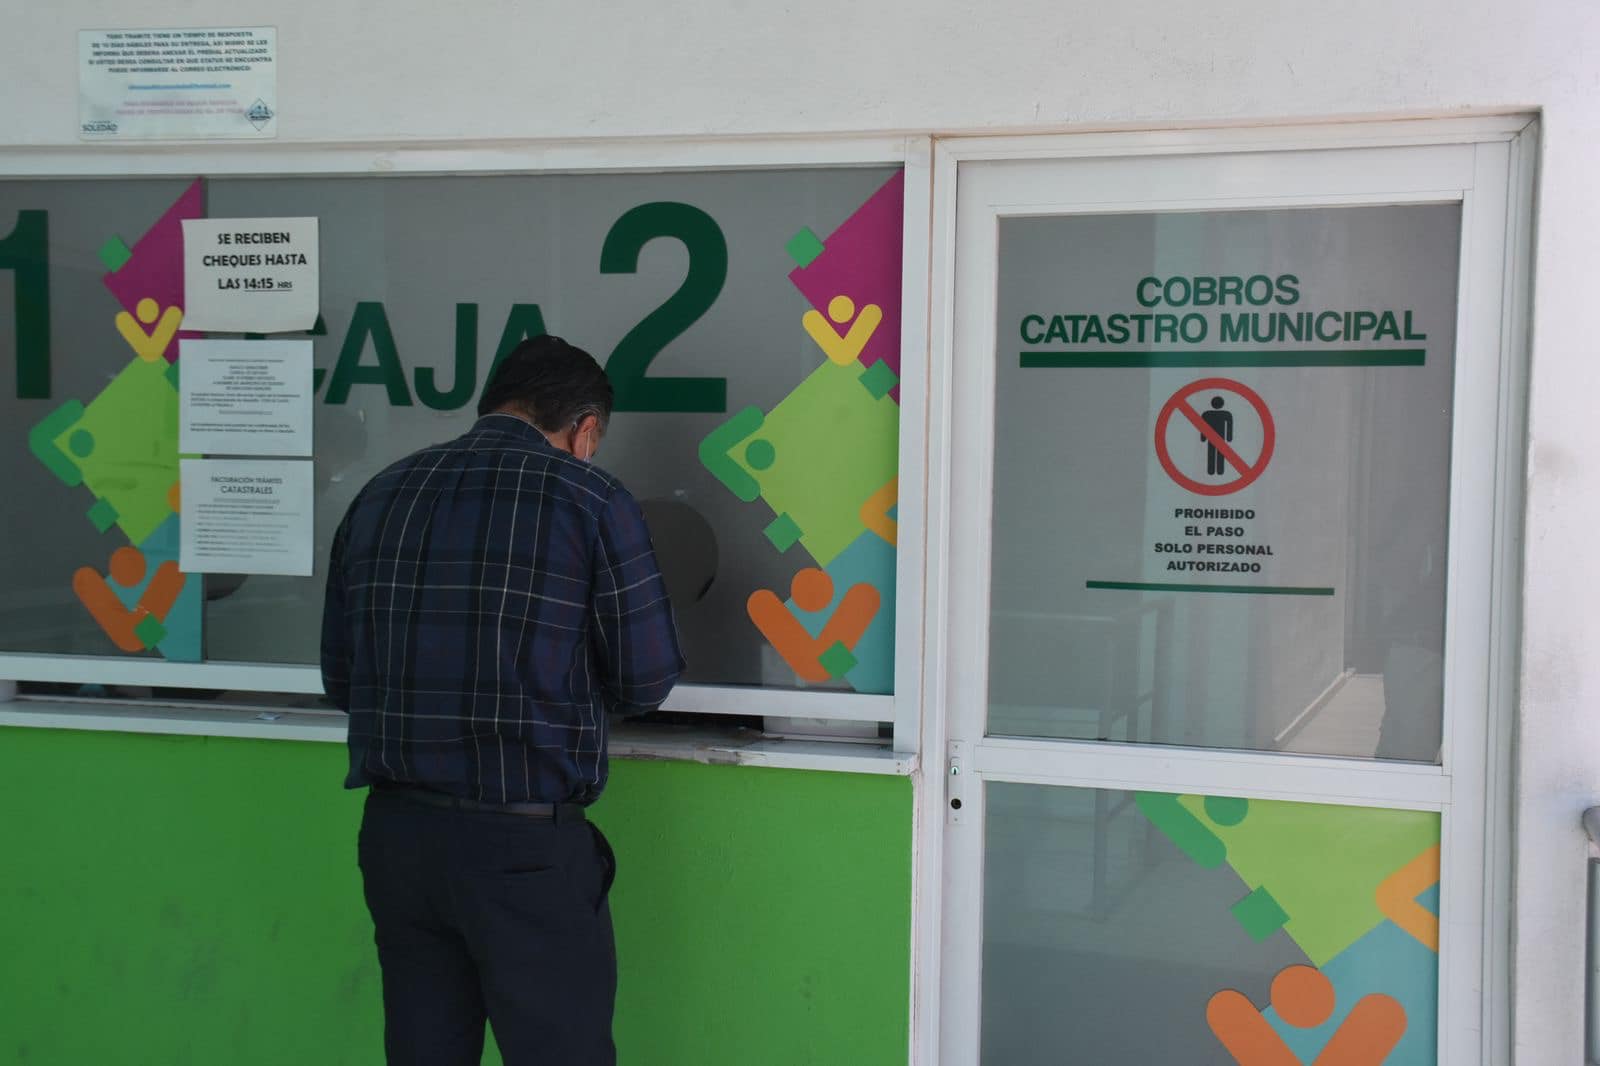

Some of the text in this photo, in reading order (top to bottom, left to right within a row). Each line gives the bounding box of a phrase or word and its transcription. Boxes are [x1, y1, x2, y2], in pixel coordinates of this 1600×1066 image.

[217, 232, 290, 245] SE RECIBEN
[203, 253, 307, 268] CHEQUES HASTA
[218, 278, 293, 290] LAS 14:15 HRS
[1136, 274, 1300, 307] COBROS
[0, 209, 51, 399] 1
[245, 201, 728, 413] AJ 2
[1020, 310, 1427, 344] CATASTRO MUNICIPAL
[220, 485, 273, 495] CATASTRALES
[1175, 508, 1255, 519] PROHIBIDO
[1185, 526, 1244, 537] EL PASO
[1154, 543, 1273, 555] SOLO PERSONAL
[1167, 561, 1261, 573] AUTORIZADO
